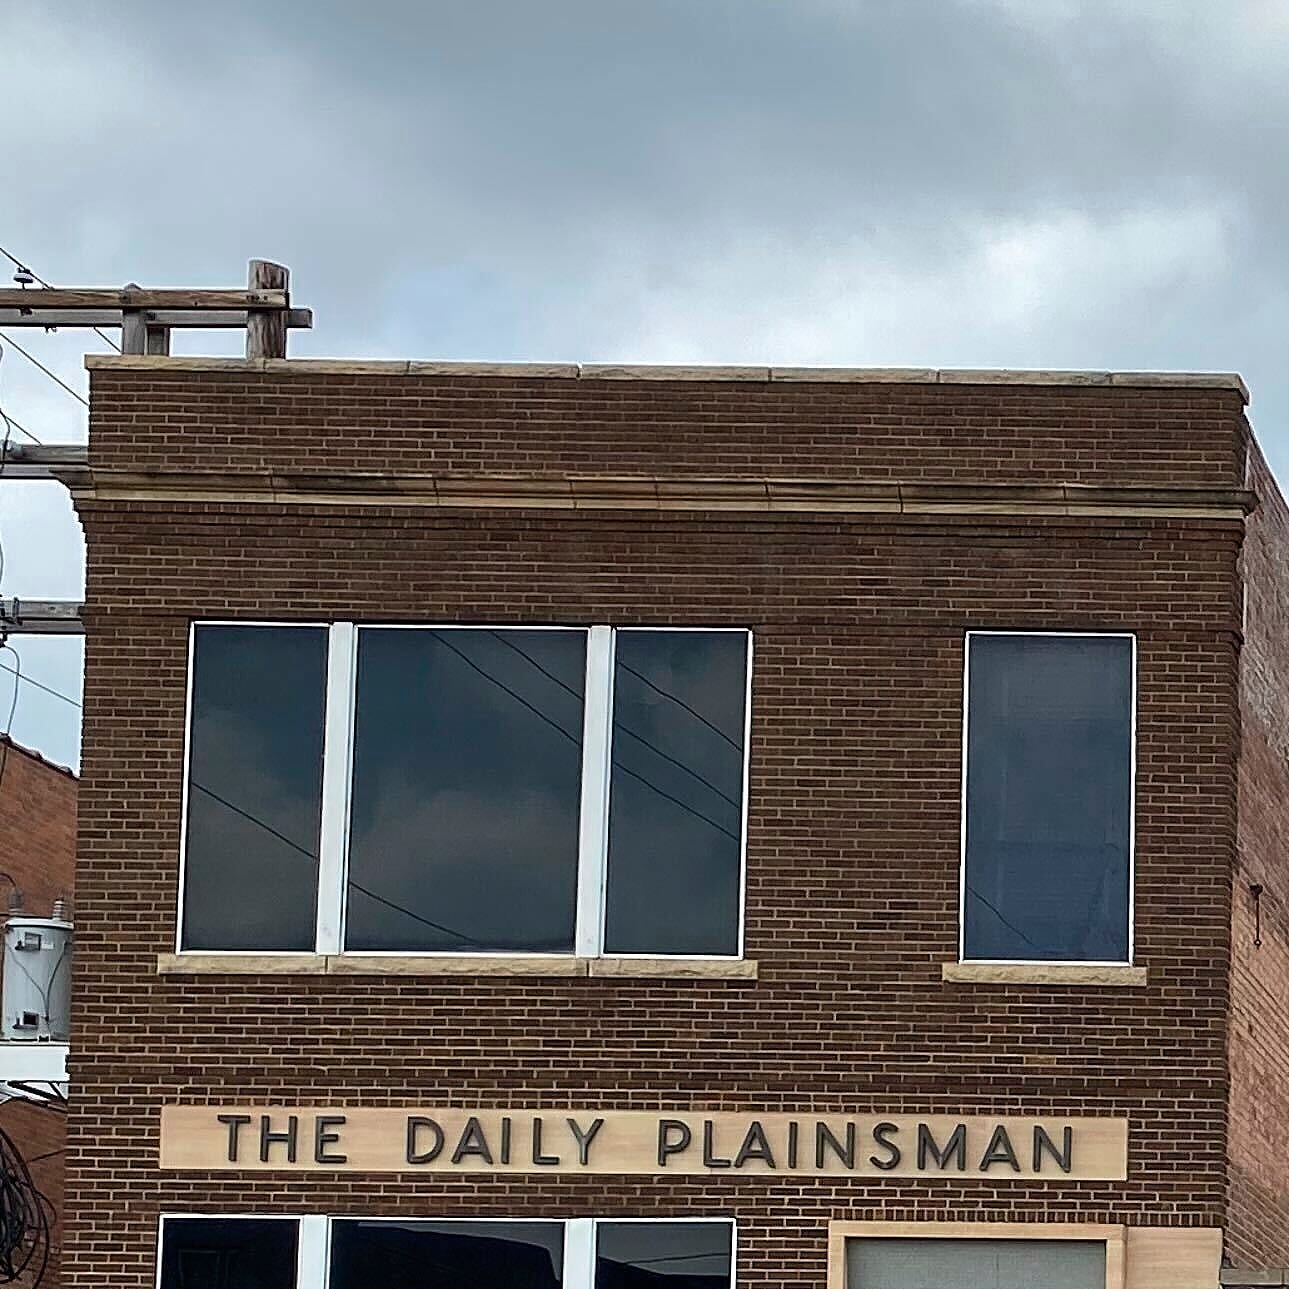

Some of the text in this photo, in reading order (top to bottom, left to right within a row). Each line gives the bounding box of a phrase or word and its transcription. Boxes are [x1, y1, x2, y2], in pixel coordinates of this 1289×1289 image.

[217, 1114, 1073, 1173] THE DAILY PLAINSMAN
